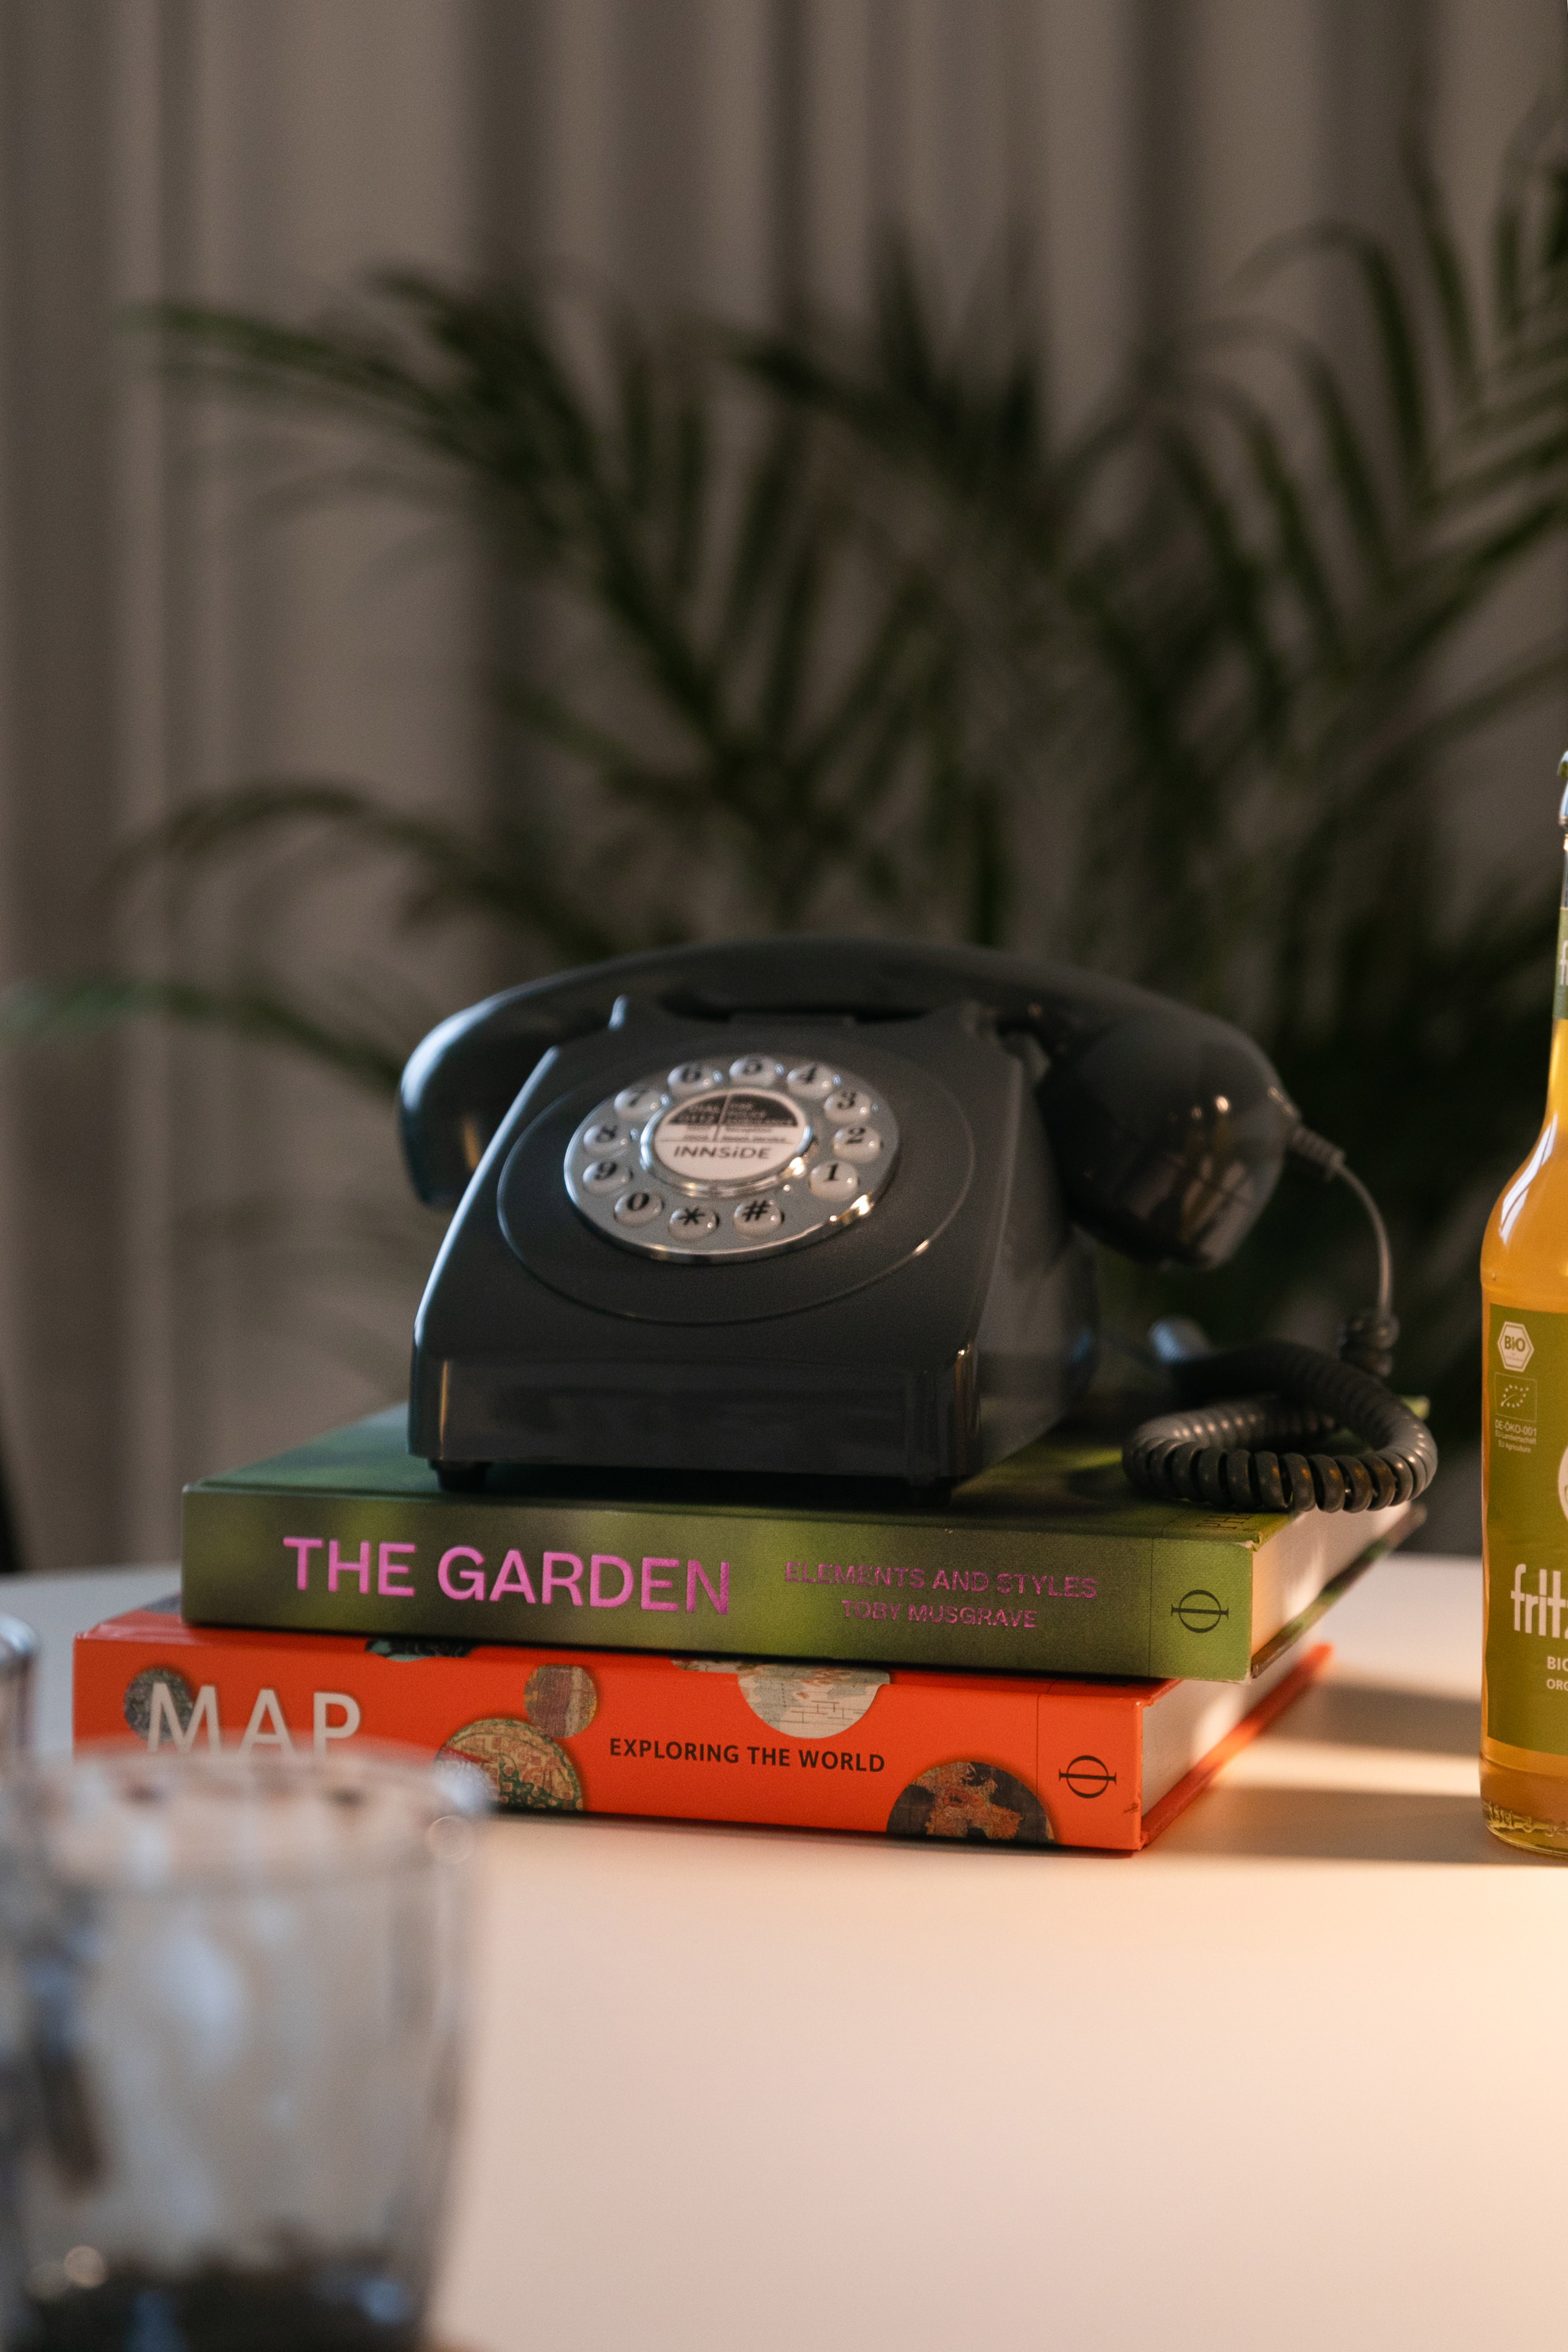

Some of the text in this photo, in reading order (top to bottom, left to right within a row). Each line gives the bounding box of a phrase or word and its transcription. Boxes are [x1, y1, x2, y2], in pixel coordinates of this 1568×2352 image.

[799, 1066, 820, 1084] 4
[627, 1089, 648, 1107] 7
[837, 1090, 858, 1109] 3
[595, 1124, 617, 1142] 8
[845, 1127, 866, 1145] 2
[595, 1161, 617, 1181] 9
[826, 1163, 838, 1181] 1
[283, 1537, 730, 1615] THE GARDEN
[785, 1561, 1097, 1598] ELEMENTS AND STYLES
[1510, 1563, 1568, 1640] frit
[842, 1599, 1038, 1628] TOBY MUSGRAVE
[147, 1682, 361, 1755] MAP
[610, 1738, 885, 1772] EXPLORING THE WORLD
